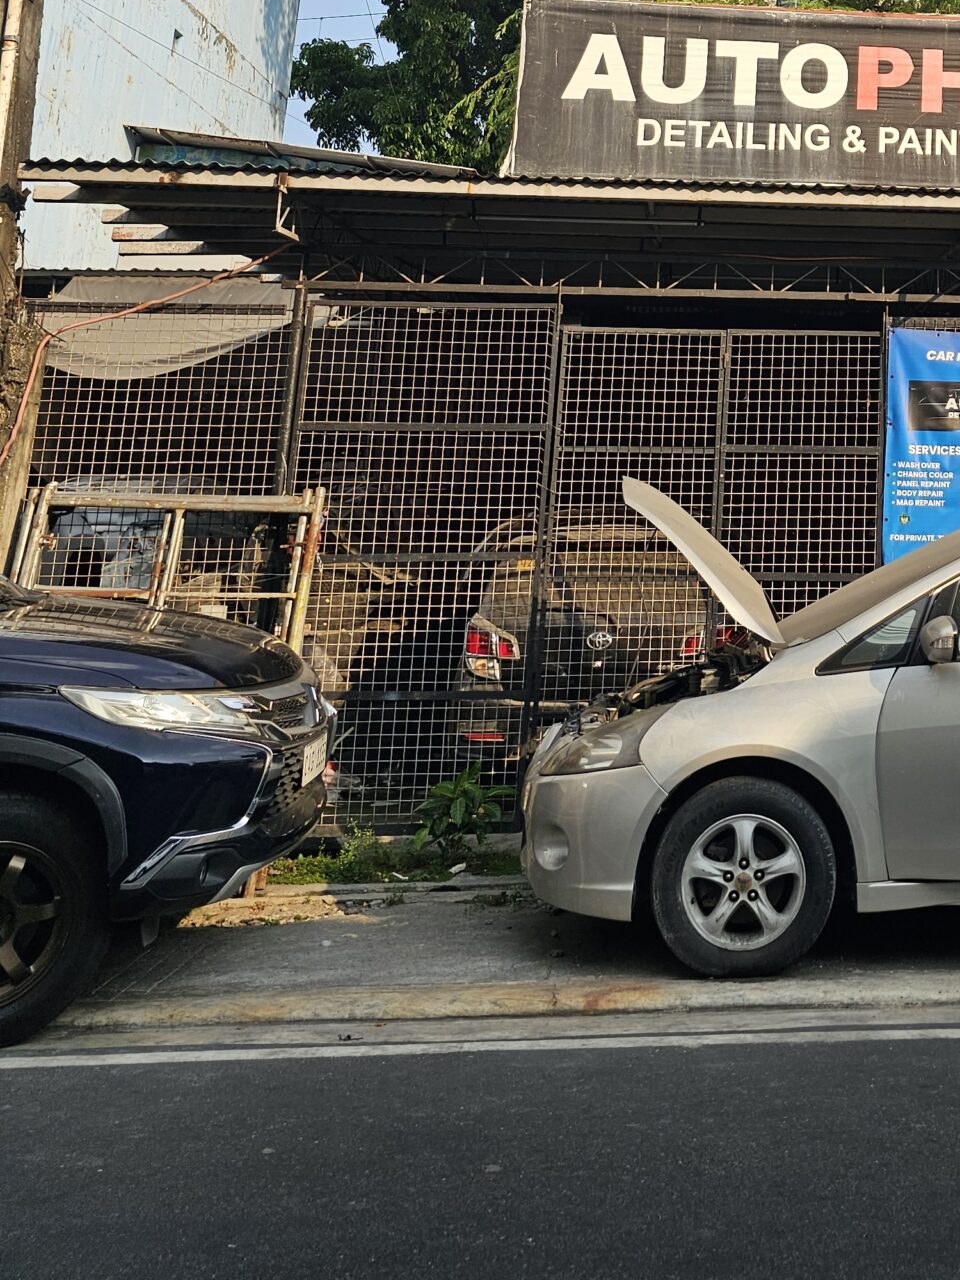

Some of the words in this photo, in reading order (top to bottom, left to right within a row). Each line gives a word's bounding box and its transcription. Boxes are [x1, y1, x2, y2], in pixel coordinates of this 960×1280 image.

[636, 117, 832, 155] DETAILING
[844, 125, 867, 154] &
[926, 350, 954, 362] CAR
[898, 461, 920, 469] WASH
[921, 462, 941, 470] OVER
[897, 470, 928, 478] CHANGE
[929, 471, 954, 479] COLOR
[896, 489, 917, 497] BODY
[918, 490, 944, 498] REPAIR
[896, 499, 914, 507] MAG
